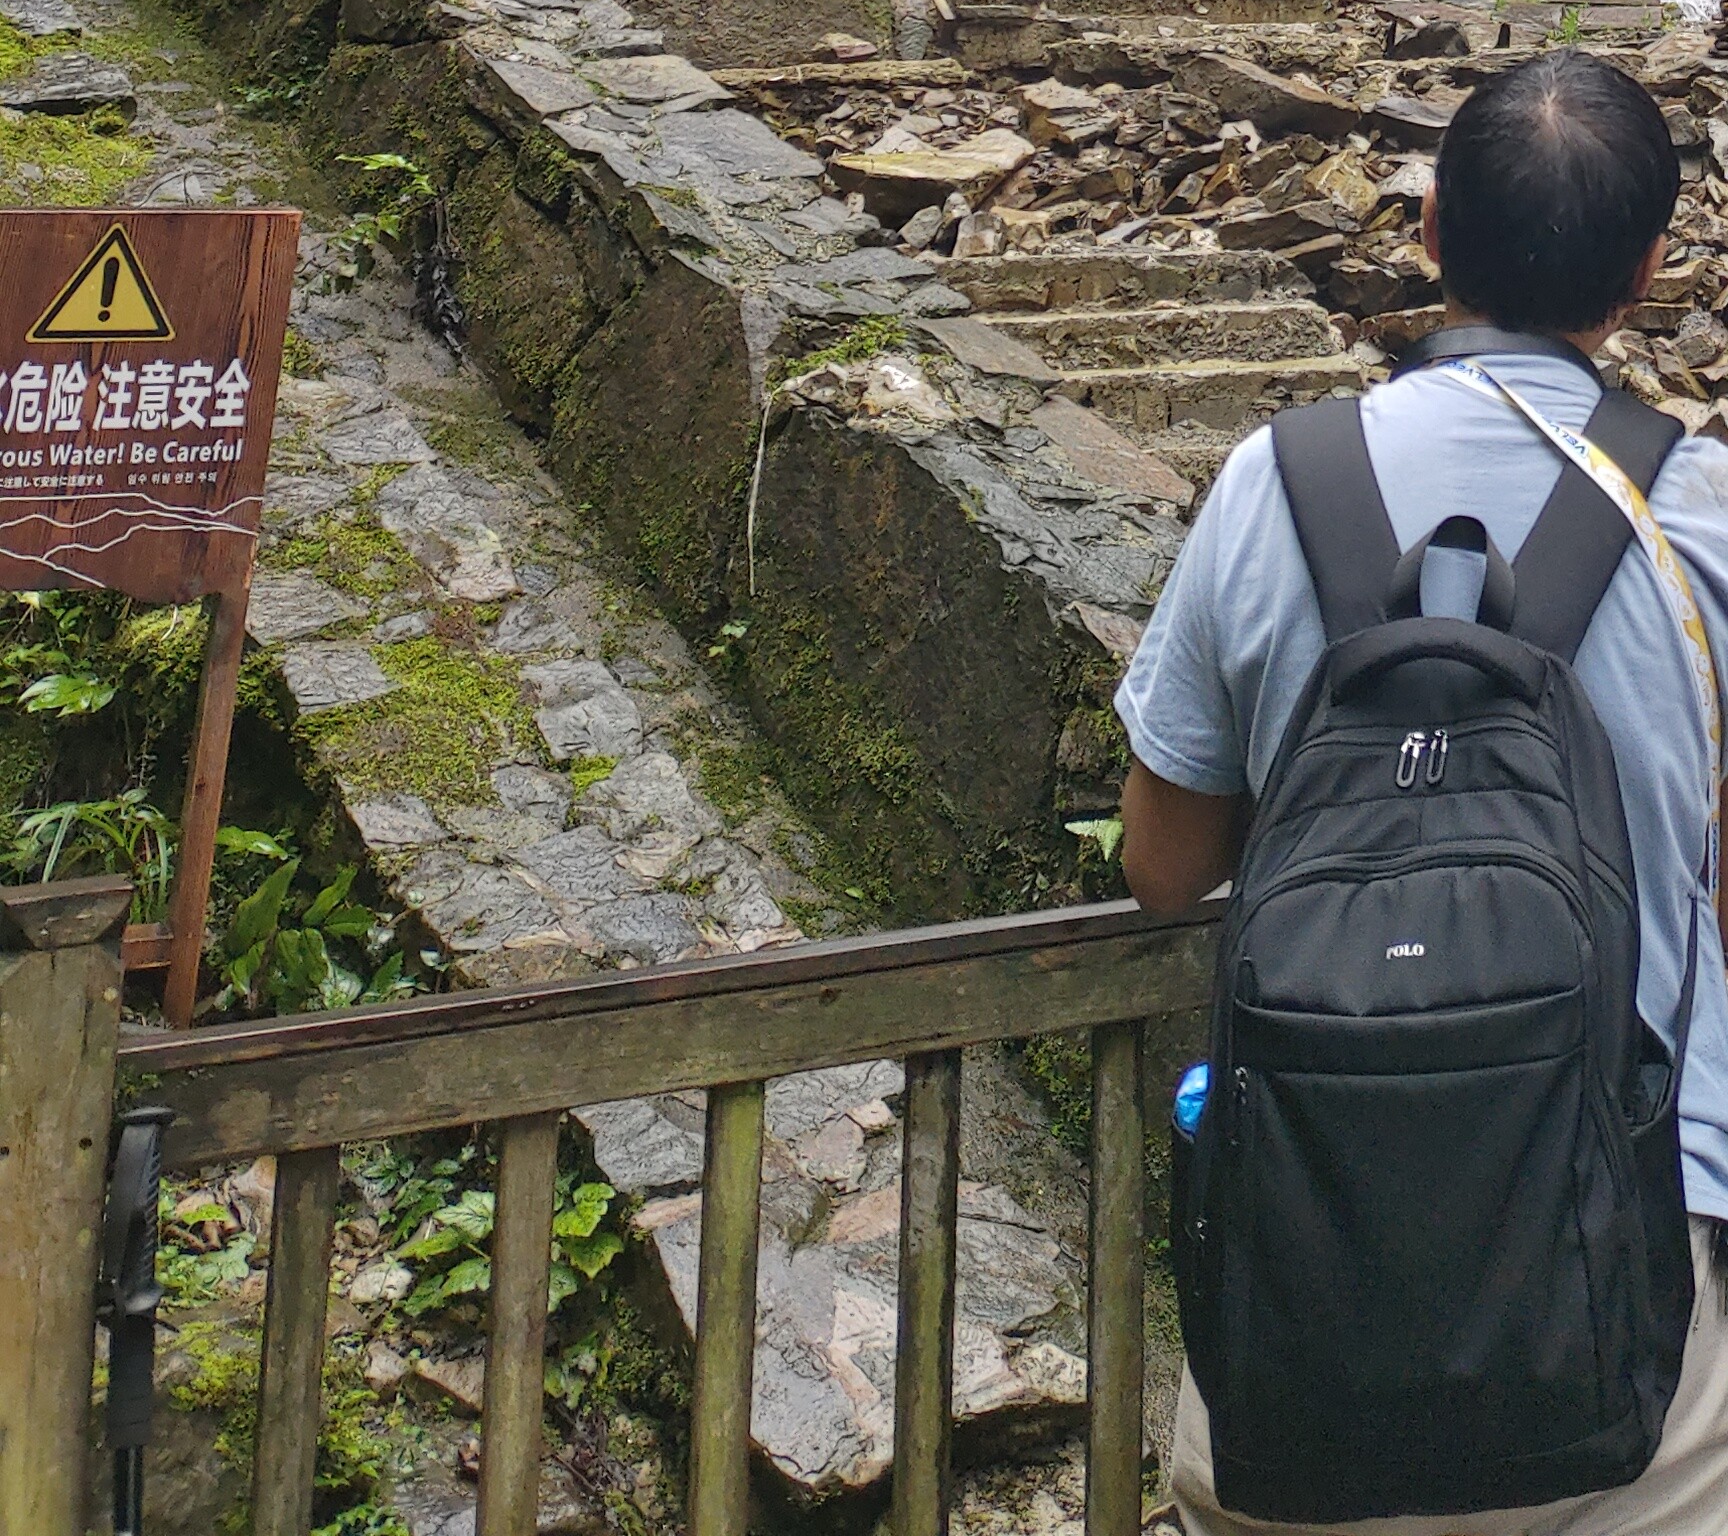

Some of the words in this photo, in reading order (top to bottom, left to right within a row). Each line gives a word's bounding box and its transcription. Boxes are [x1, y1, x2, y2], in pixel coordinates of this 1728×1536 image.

[93, 358, 250, 431] 注意安全
[0, 449, 44, 468] ous
[49, 442, 125, 466] Water!
[130, 442, 158, 464] Be
[162, 438, 244, 464] Careful
